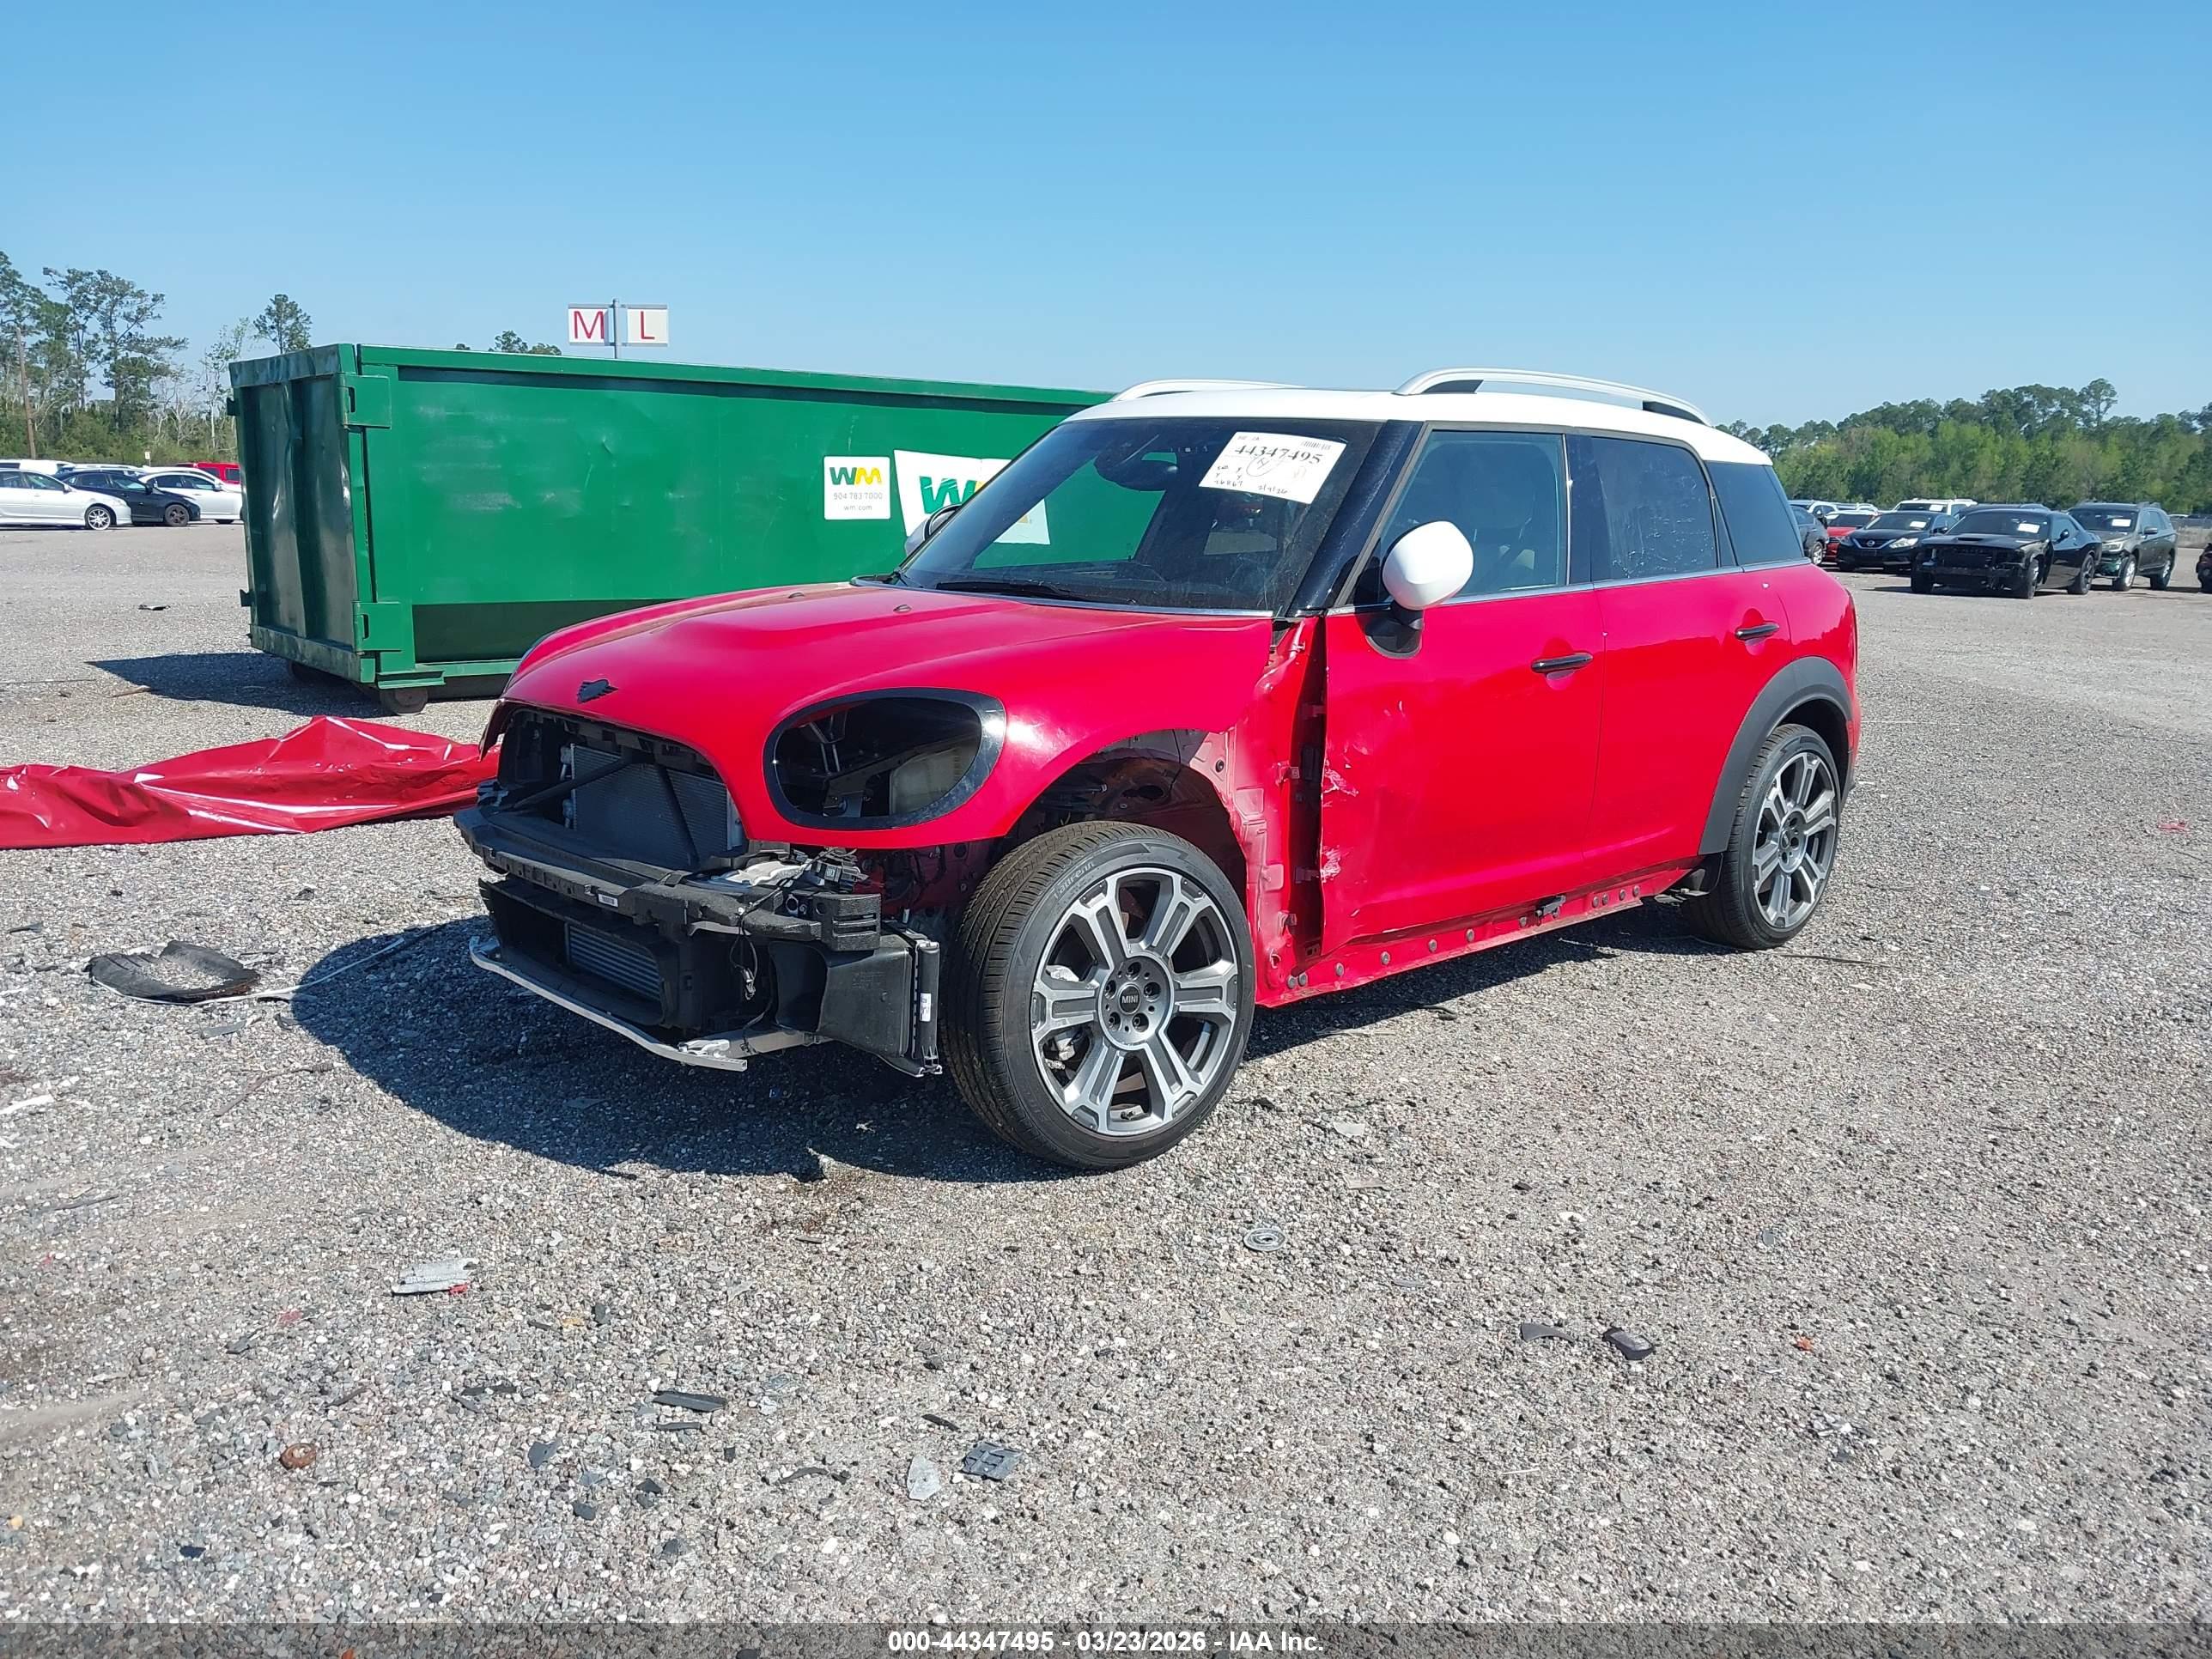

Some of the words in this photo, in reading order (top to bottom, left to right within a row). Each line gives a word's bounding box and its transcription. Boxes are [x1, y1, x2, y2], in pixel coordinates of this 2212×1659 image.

[574, 310, 605, 339] M
[640, 310, 655, 339] L
[1235, 445, 1323, 465] 44347495
[830, 467, 882, 485] WM
[833, 492, 848, 501] 904
[865, 492, 884, 501] 7000
[1121, 994, 1139, 1004] MINI
